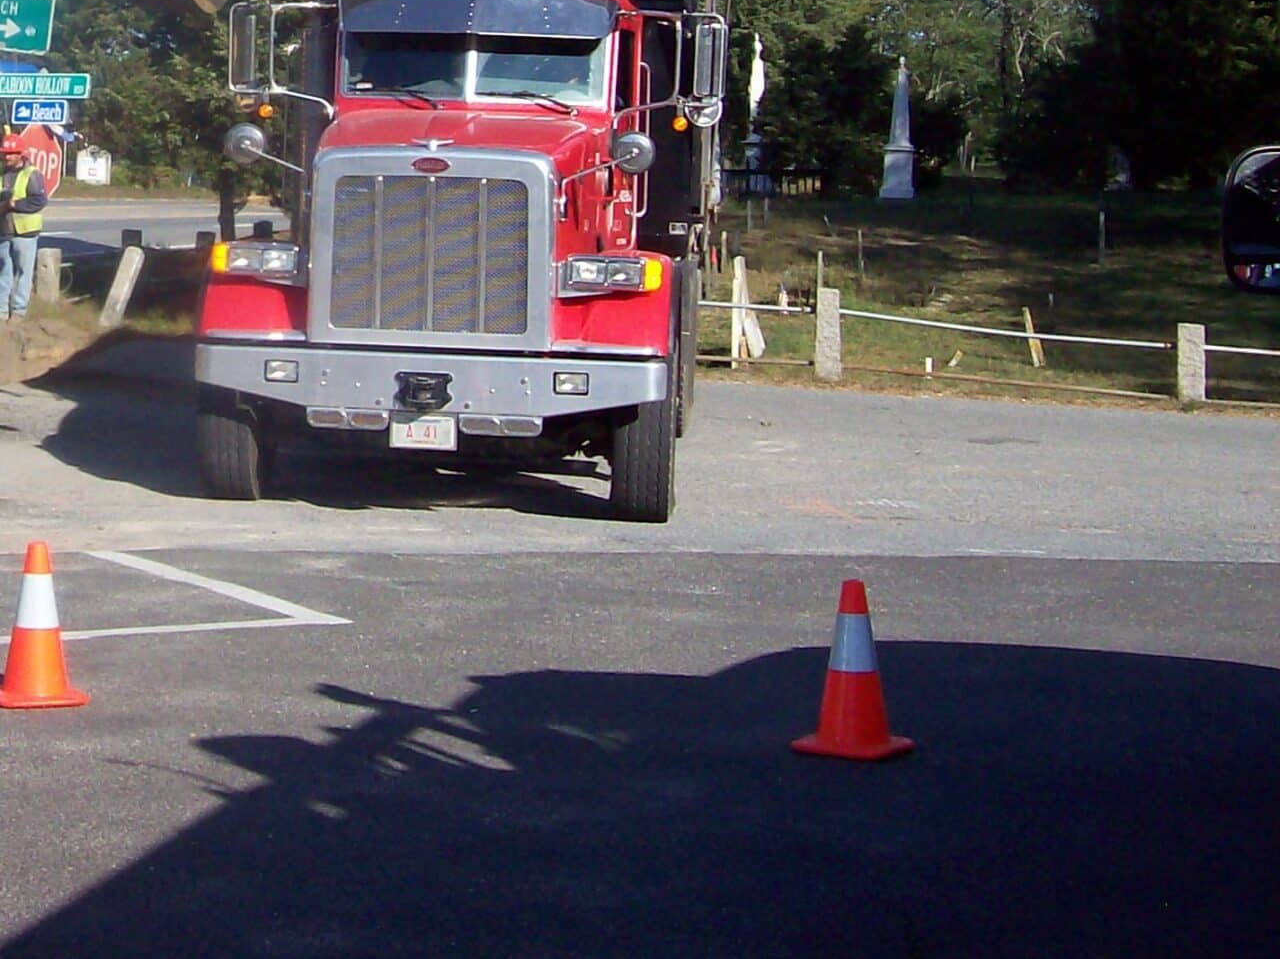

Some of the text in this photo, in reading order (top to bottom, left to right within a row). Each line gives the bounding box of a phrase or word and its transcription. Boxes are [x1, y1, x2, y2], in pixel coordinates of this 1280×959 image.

[35, 77, 72, 94] HOLLOW
[33, 103, 62, 121] Beach
[27, 147, 59, 180] TOP
